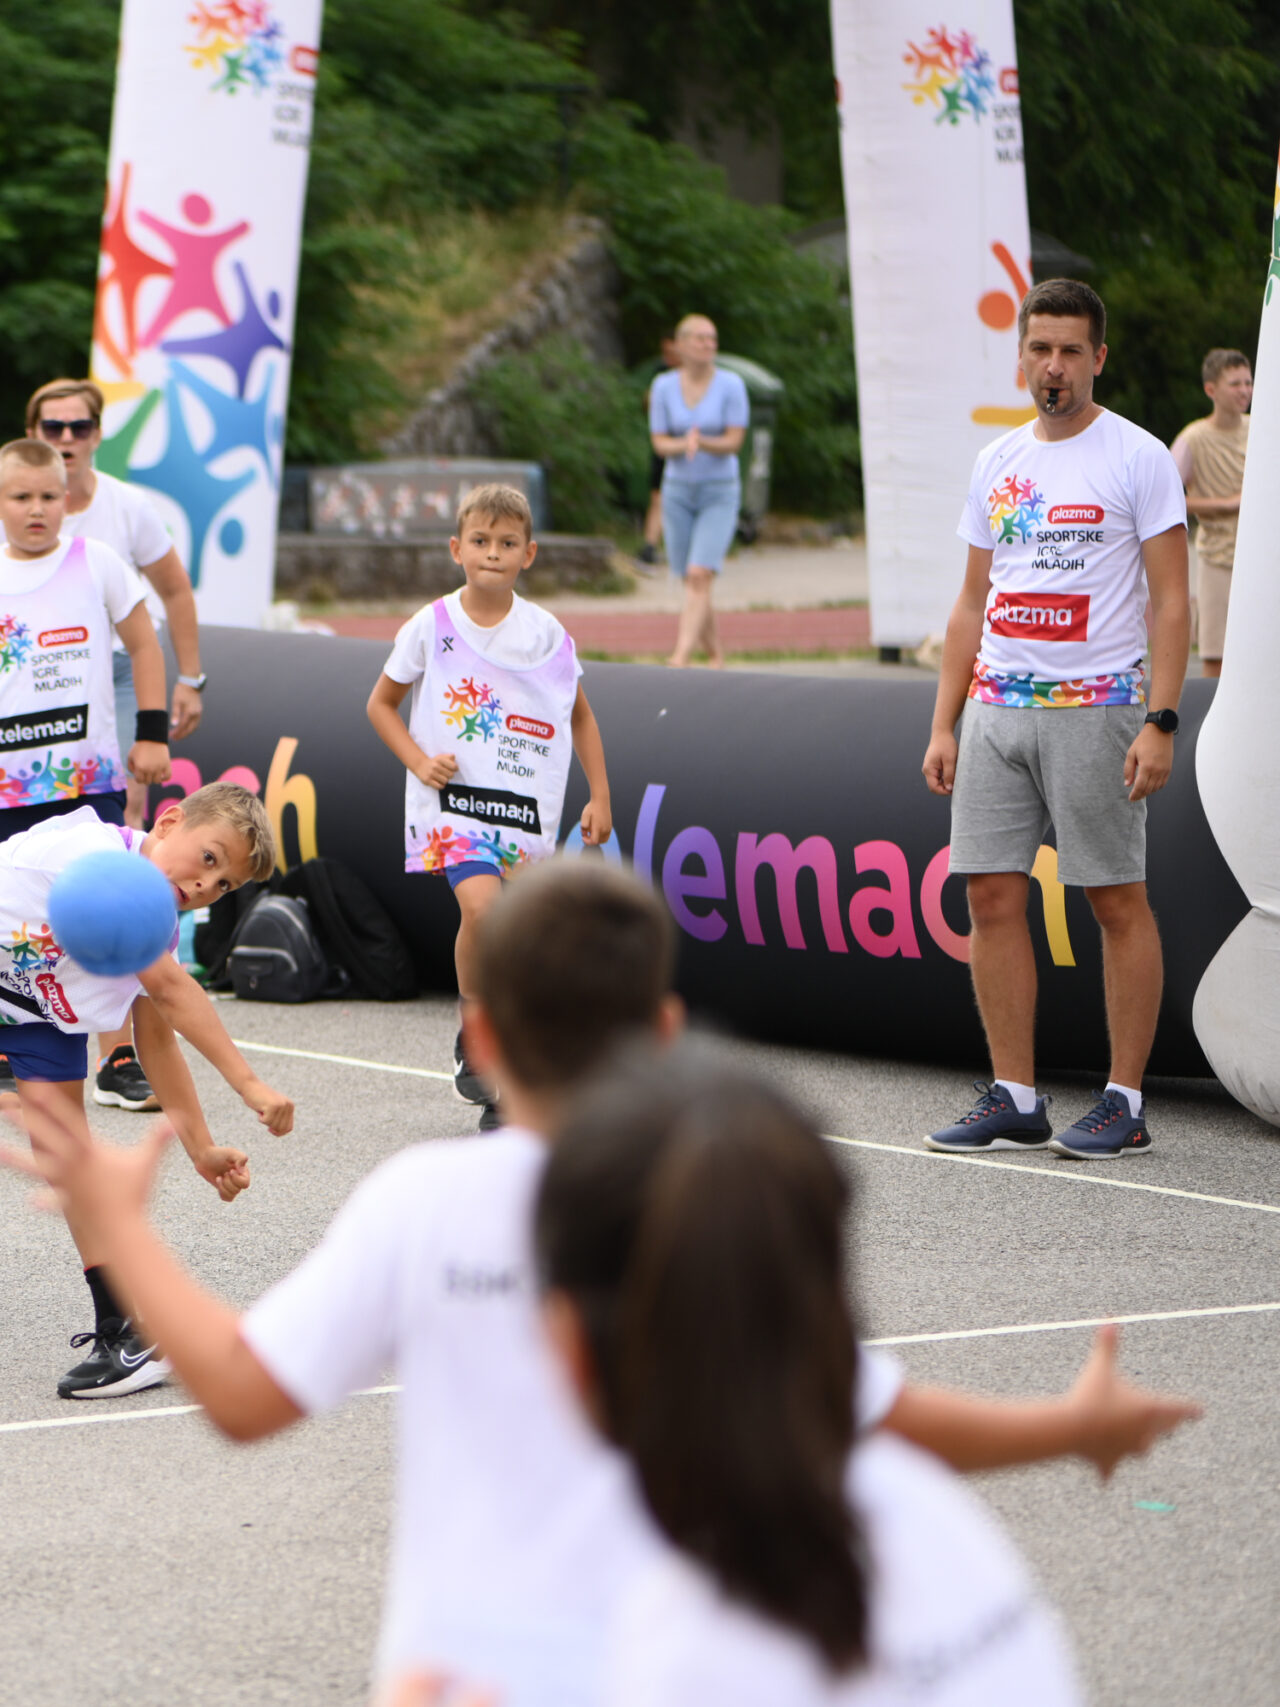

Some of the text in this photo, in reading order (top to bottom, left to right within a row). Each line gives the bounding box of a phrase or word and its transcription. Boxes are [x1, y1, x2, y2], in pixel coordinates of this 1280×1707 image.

[1051, 507, 1096, 523] plazma
[1036, 530, 1105, 543] SPORTSKE
[1031, 558, 1085, 570] MLADIH
[30, 648, 91, 667] SPORTSKE
[32, 666, 61, 680] IGRE
[34, 677, 82, 693] MLADIH
[509, 718, 550, 735] plazma
